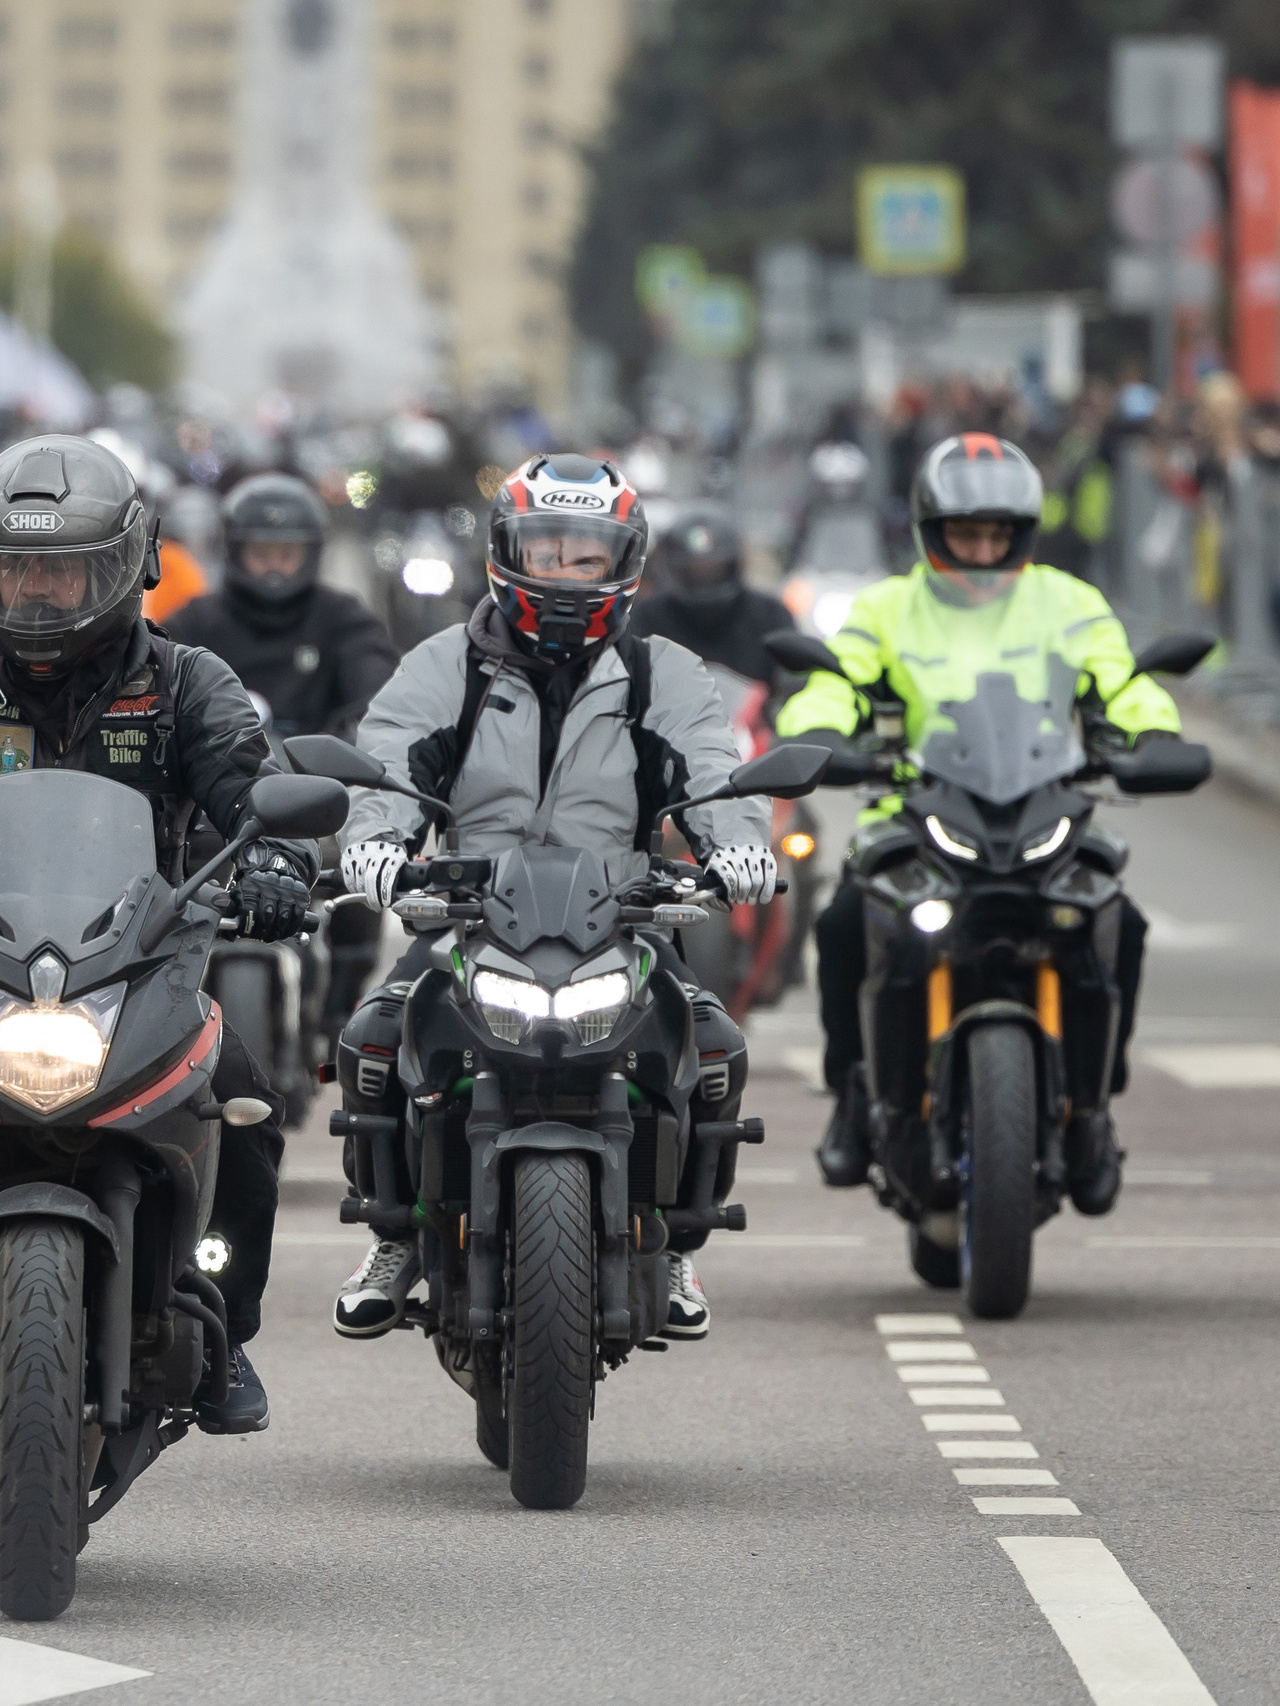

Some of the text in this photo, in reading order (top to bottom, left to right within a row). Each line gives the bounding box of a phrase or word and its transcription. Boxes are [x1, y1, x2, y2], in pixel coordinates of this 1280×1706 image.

[550, 494, 599, 507] HJC
[9, 514, 56, 530] SHOEI
[100, 729, 148, 746] Traffic
[109, 747, 142, 764] Bike
